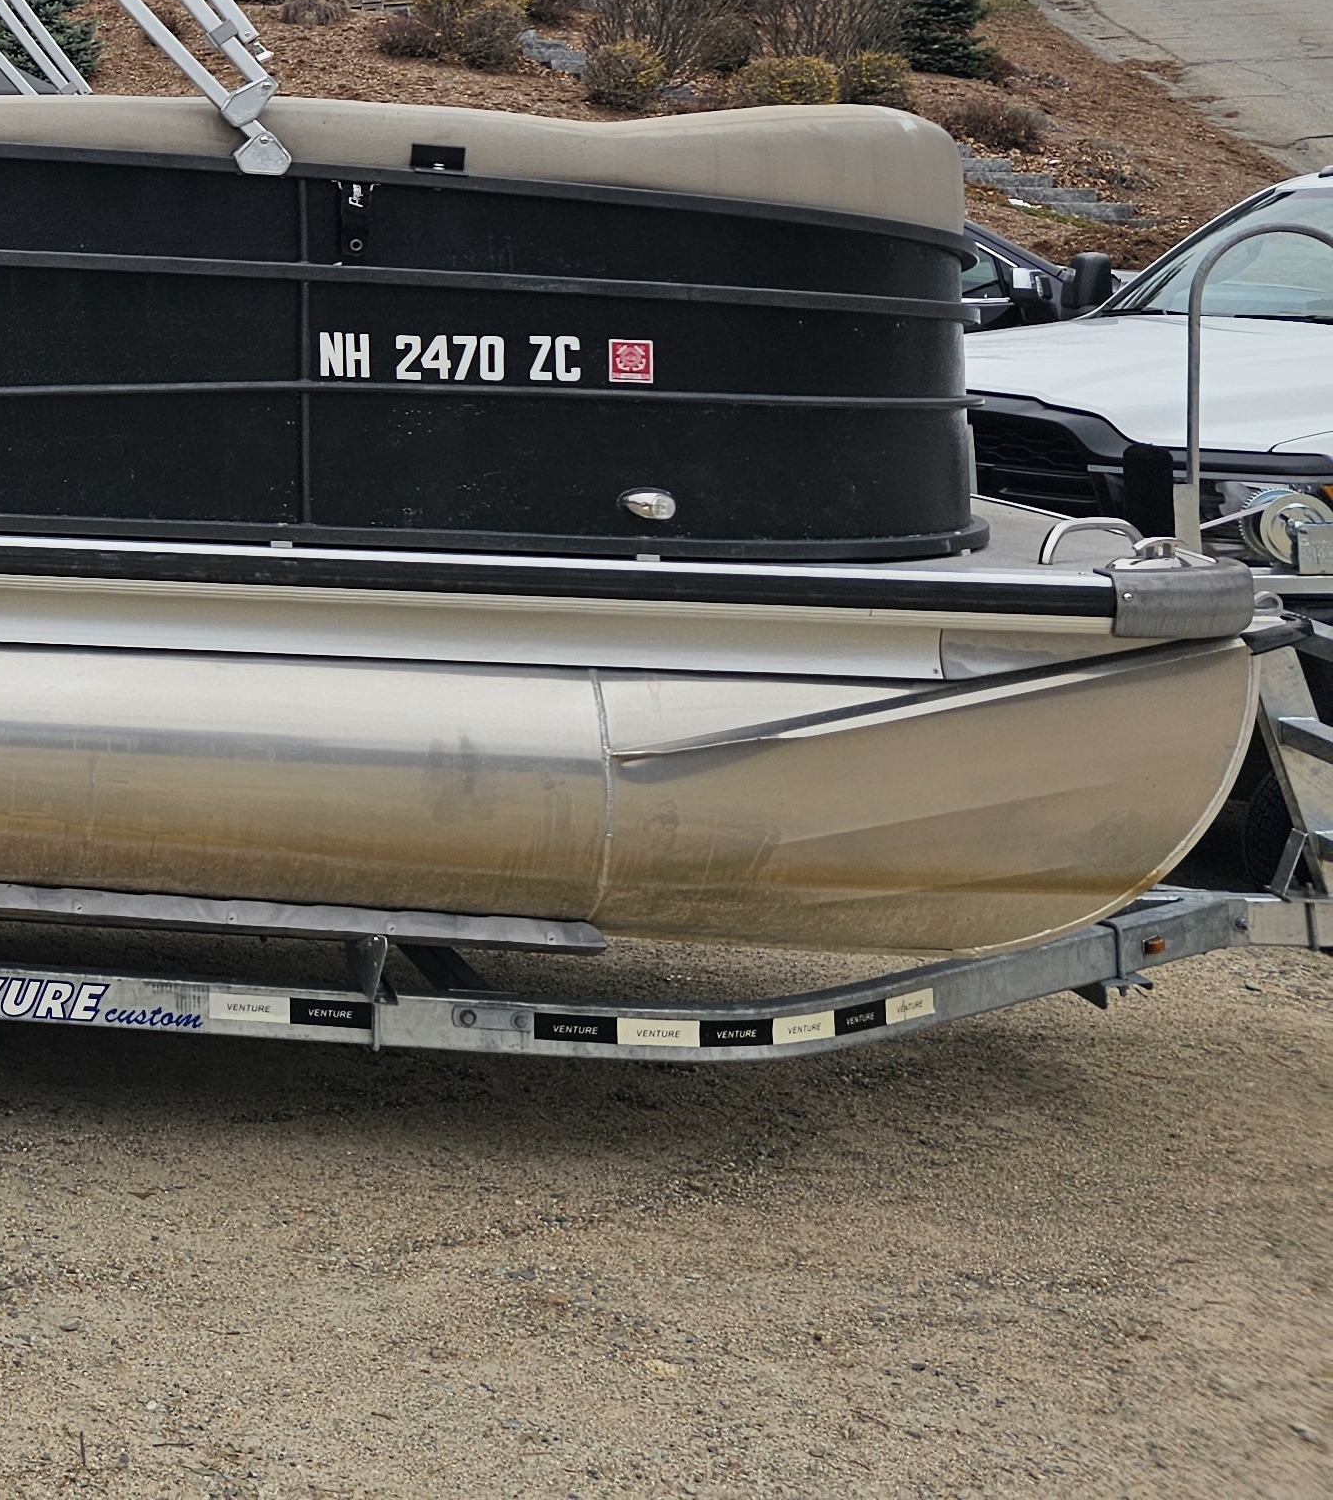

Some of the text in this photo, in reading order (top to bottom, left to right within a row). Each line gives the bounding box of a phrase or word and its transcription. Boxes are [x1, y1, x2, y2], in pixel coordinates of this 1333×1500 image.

[319, 331, 581, 382] NH 2470 ZC
[104, 1005, 204, 1030] custom
[226, 1002, 353, 1019] VENTURE VENTURE
[552, 1025, 599, 1035] VENTURE
[636, 1029, 682, 1038] VENTURE
[716, 1029, 758, 1039] VENTURE
[787, 1022, 821, 1035] VENTURE
[846, 1011, 875, 1026] VENTURE
